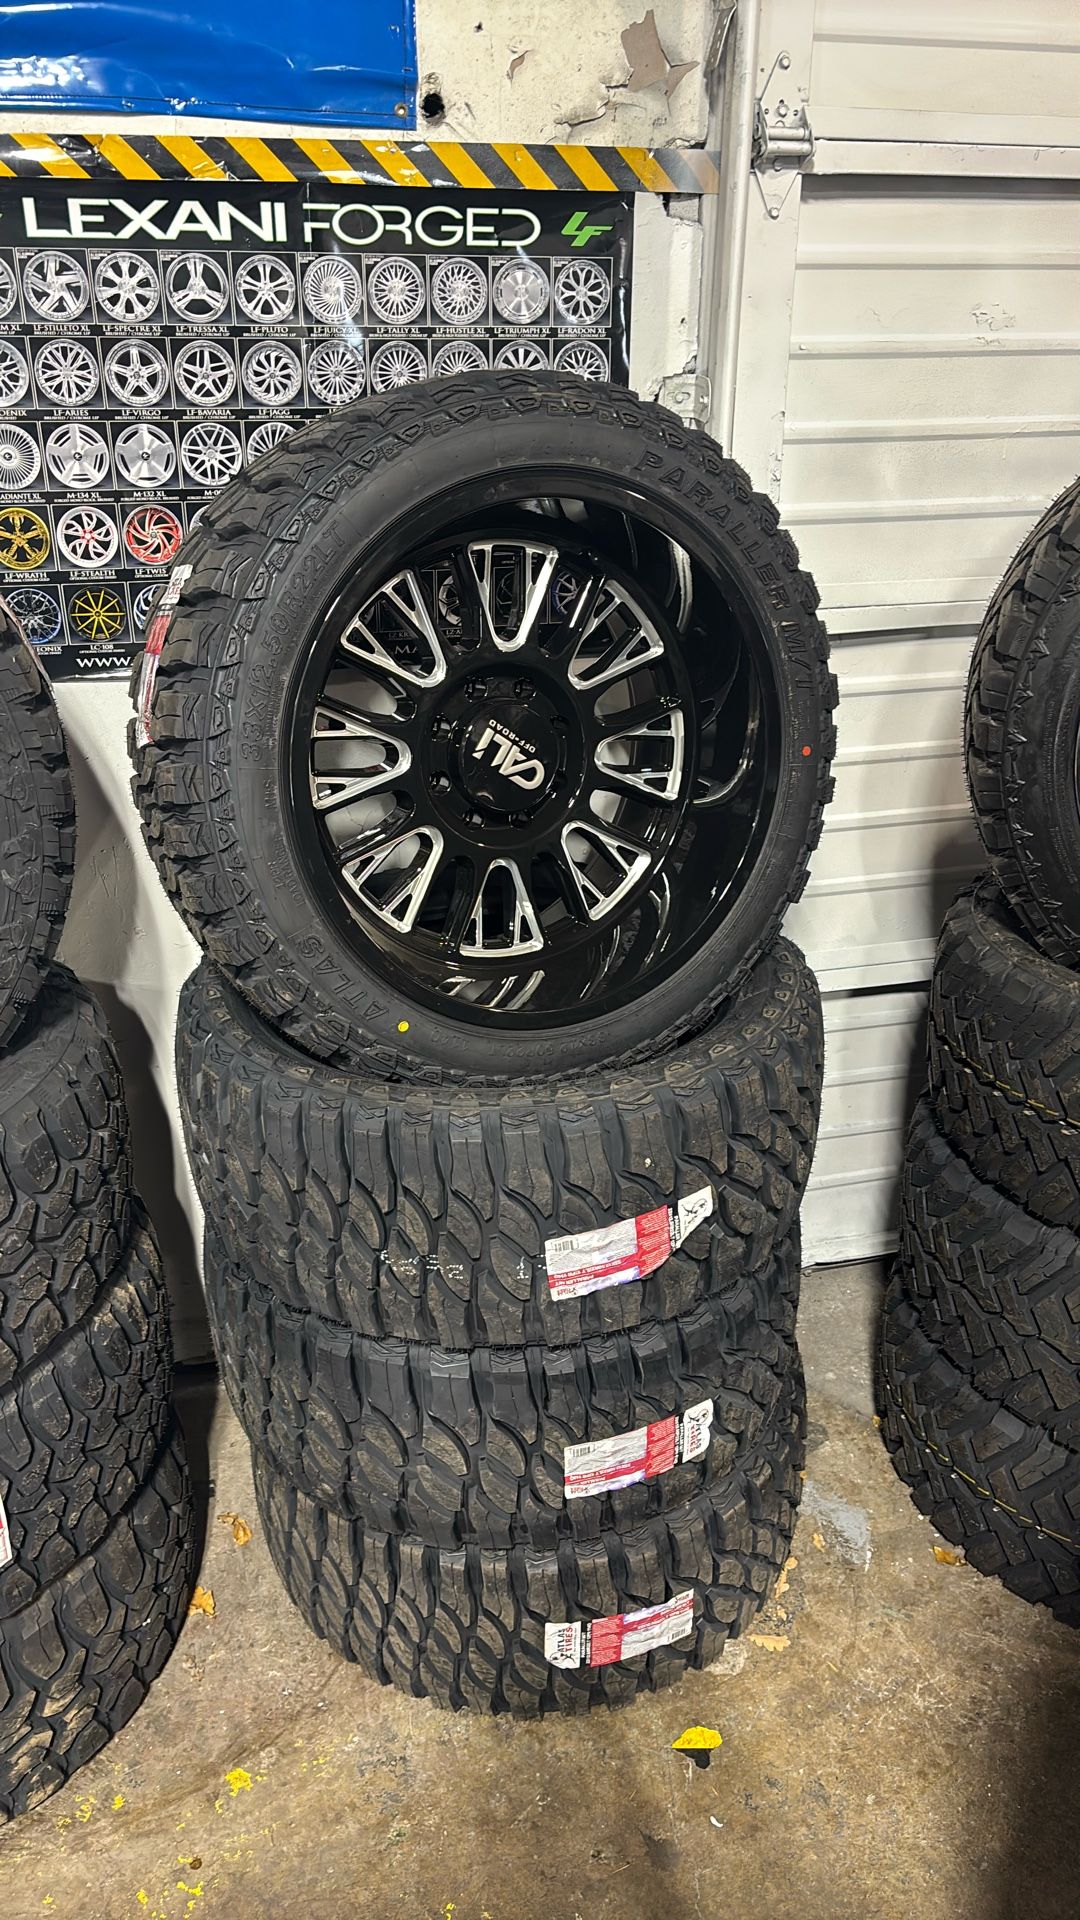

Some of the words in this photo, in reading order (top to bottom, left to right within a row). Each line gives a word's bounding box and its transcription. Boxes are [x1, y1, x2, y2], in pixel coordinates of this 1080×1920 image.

[22, 197, 287, 242] LEXANI
[302, 203, 541, 247] FORGED
[259, 409, 290, 417] LF-JAGG
[634, 451, 792, 612] PARALLER
[779, 621, 814, 690] M/T
[241, 519, 346, 762] 33X12.50R22LT
[471, 727, 545, 790] CALI
[488, 719, 536, 754] OFF-ROAD
[300, 934, 389, 1020] ATLAS
[565, 1626, 574, 1653] TIRES
